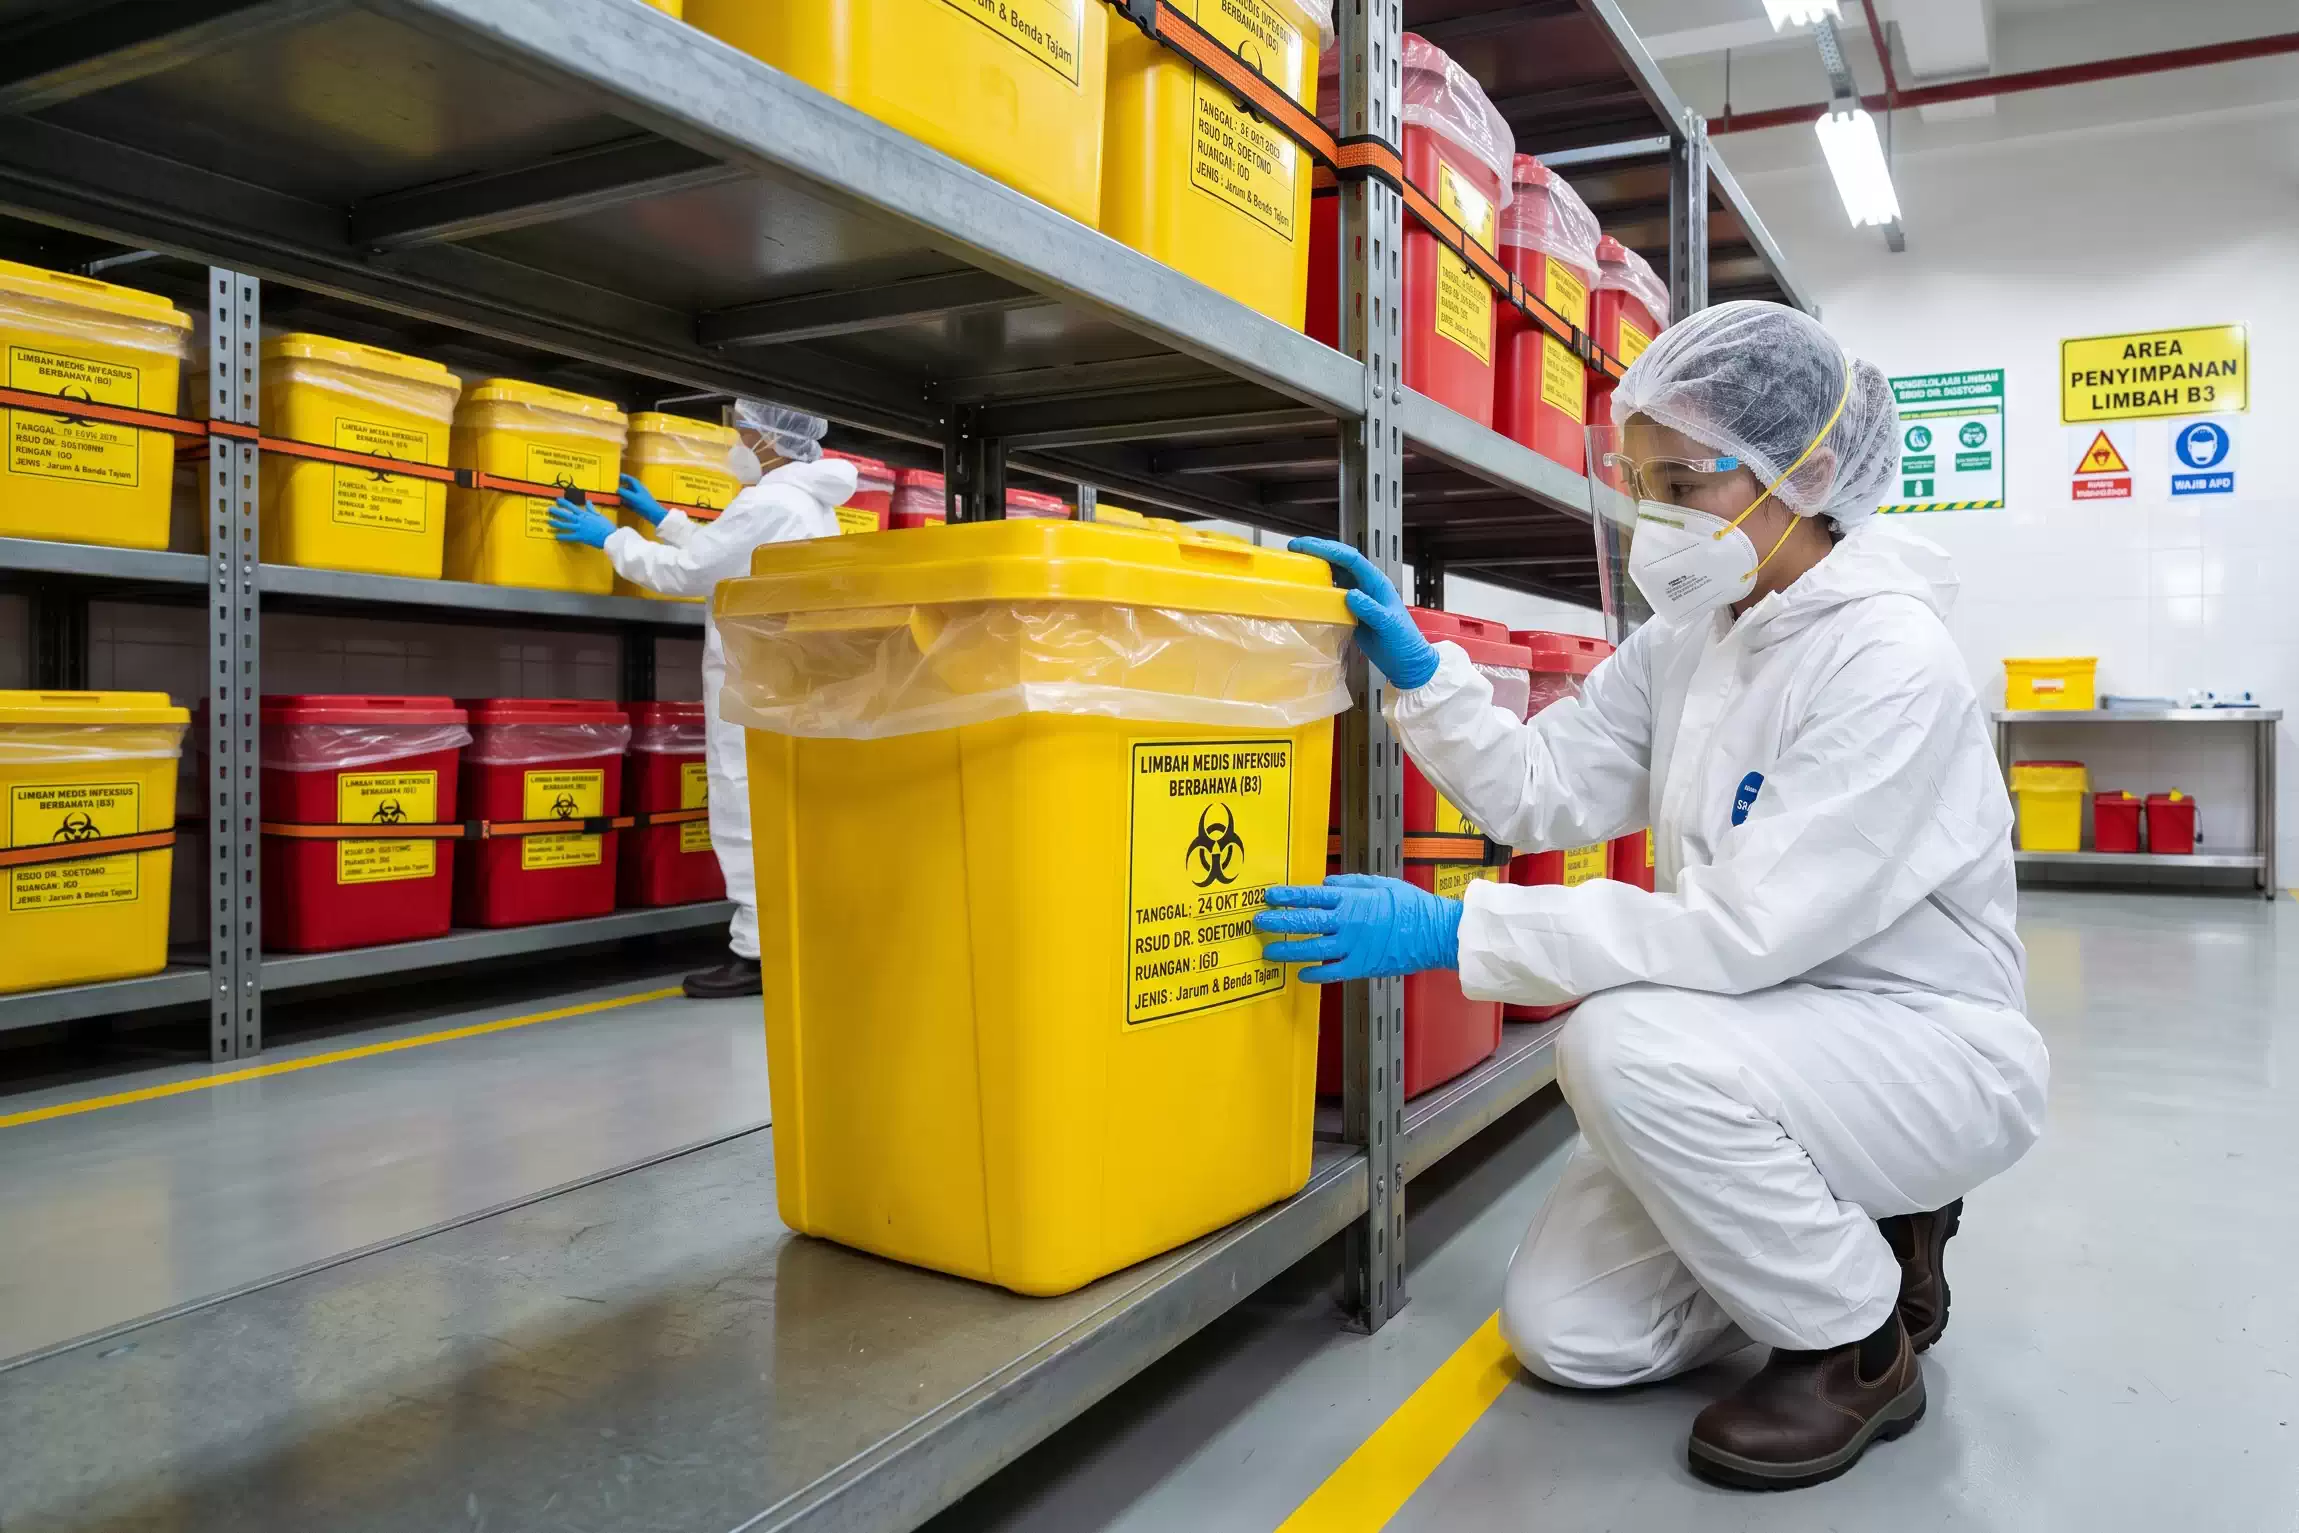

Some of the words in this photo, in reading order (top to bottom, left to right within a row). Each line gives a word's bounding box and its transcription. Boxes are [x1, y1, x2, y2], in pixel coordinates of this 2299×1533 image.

[999, 3, 1007, 22] &
[1011, 10, 1043, 45] Benda
[1045, 33, 1072, 65] Tajam
[1222, 133, 1237, 152] DR.
[2123, 340, 2183, 360] AREA
[2072, 359, 2237, 388] PENYIMPANAN
[2092, 388, 2178, 410] LIMBAH
[2188, 385, 2216, 403] B3
[1141, 755, 1189, 774] LIMBAH
[1193, 753, 1230, 771] MEDIS
[1232, 751, 1286, 770] INFEKSIUS
[1169, 776, 1237, 797] BERBAHAYA
[1240, 774, 1262, 796] (B3)
[1198, 896, 1212, 914] 24
[1216, 893, 1238, 911] OKT
[1135, 934, 1170, 954] RSUD
[1174, 930, 1194, 948] DR.
[1198, 920, 1252, 943] SOETOMO
[1199, 951, 1219, 970] IGD
[1176, 983, 1209, 1001] Jarum
[1212, 979, 1220, 993] &
[1223, 972, 1252, 991] Benda
